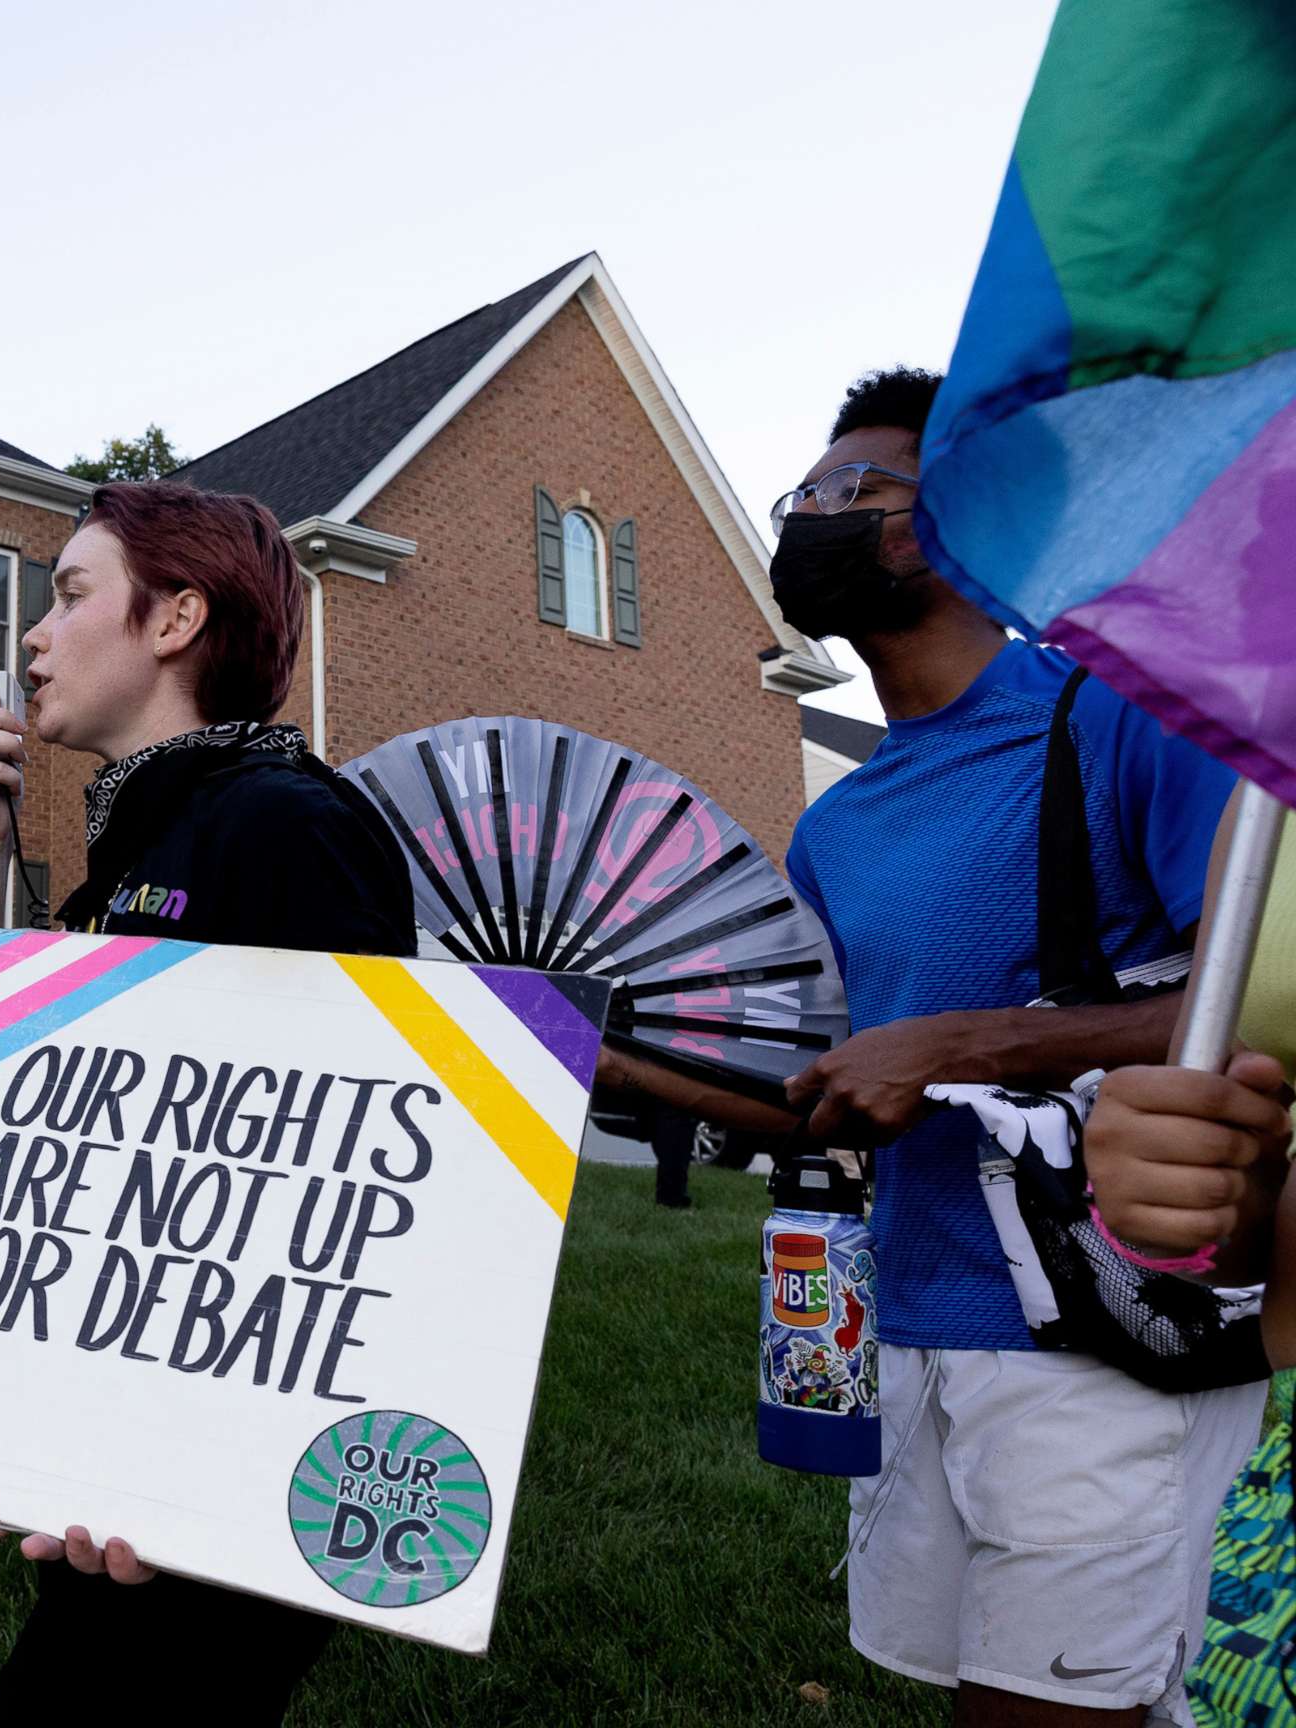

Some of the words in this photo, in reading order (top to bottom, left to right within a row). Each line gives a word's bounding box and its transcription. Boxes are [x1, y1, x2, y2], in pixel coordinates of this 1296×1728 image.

[0, 1044, 146, 1142] OUR
[141, 1053, 442, 1183] RIGHTS
[105, 1149, 290, 1262] NOT
[288, 1176, 415, 1281] UP
[75, 1244, 393, 1404] DEBATE
[337, 1473, 441, 1520] RIGHTS
[343, 1443, 440, 1493] OUR
[324, 1500, 434, 1577] DC
